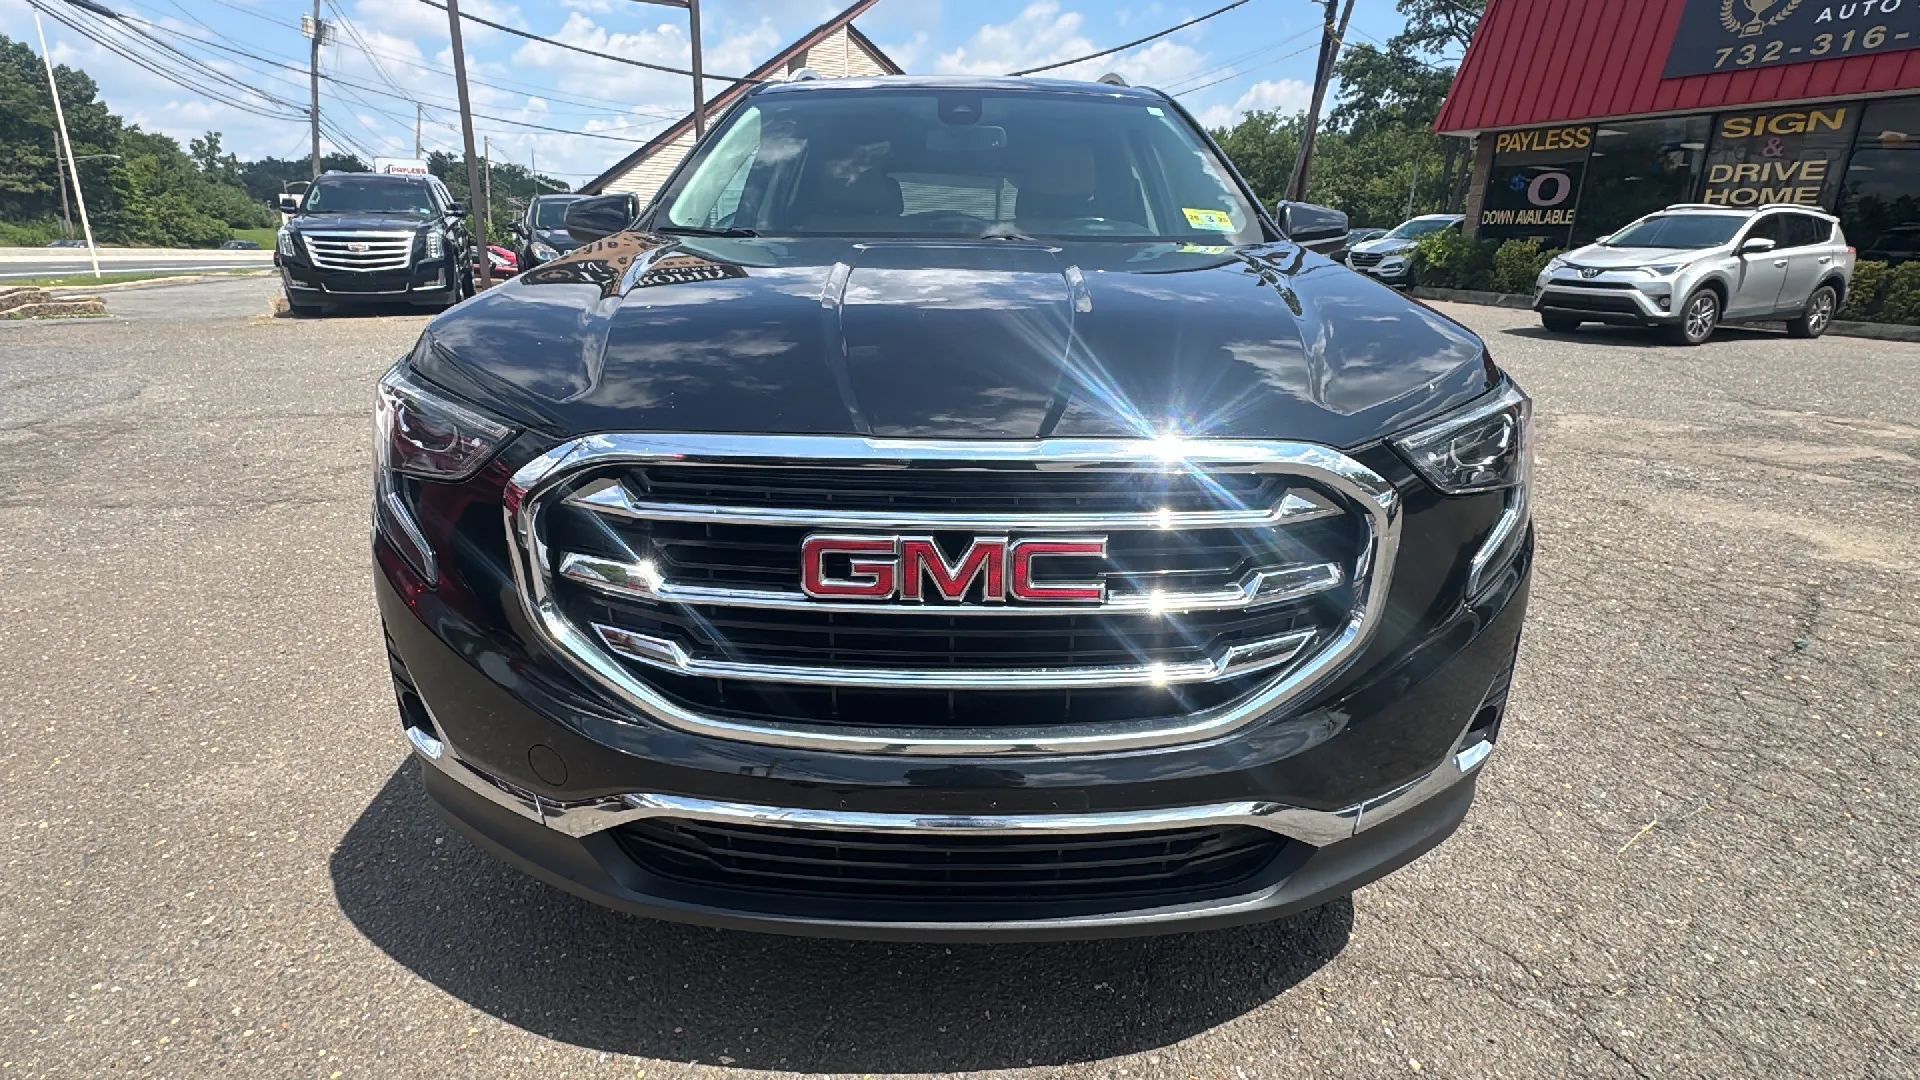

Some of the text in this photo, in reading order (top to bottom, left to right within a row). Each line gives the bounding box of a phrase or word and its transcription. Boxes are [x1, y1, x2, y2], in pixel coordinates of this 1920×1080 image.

[1814, 0, 1901, 24] AUTO
[1721, 108, 1847, 139] SIGN
[1495, 127, 1591, 154] PAYLESS
[1762, 137, 1785, 157] &
[1708, 159, 1828, 183] DRIVE
[1703, 186, 1821, 205] HOME
[1481, 209, 1575, 225] DOWN AVAILABLE
[801, 534, 1109, 604] GMC
